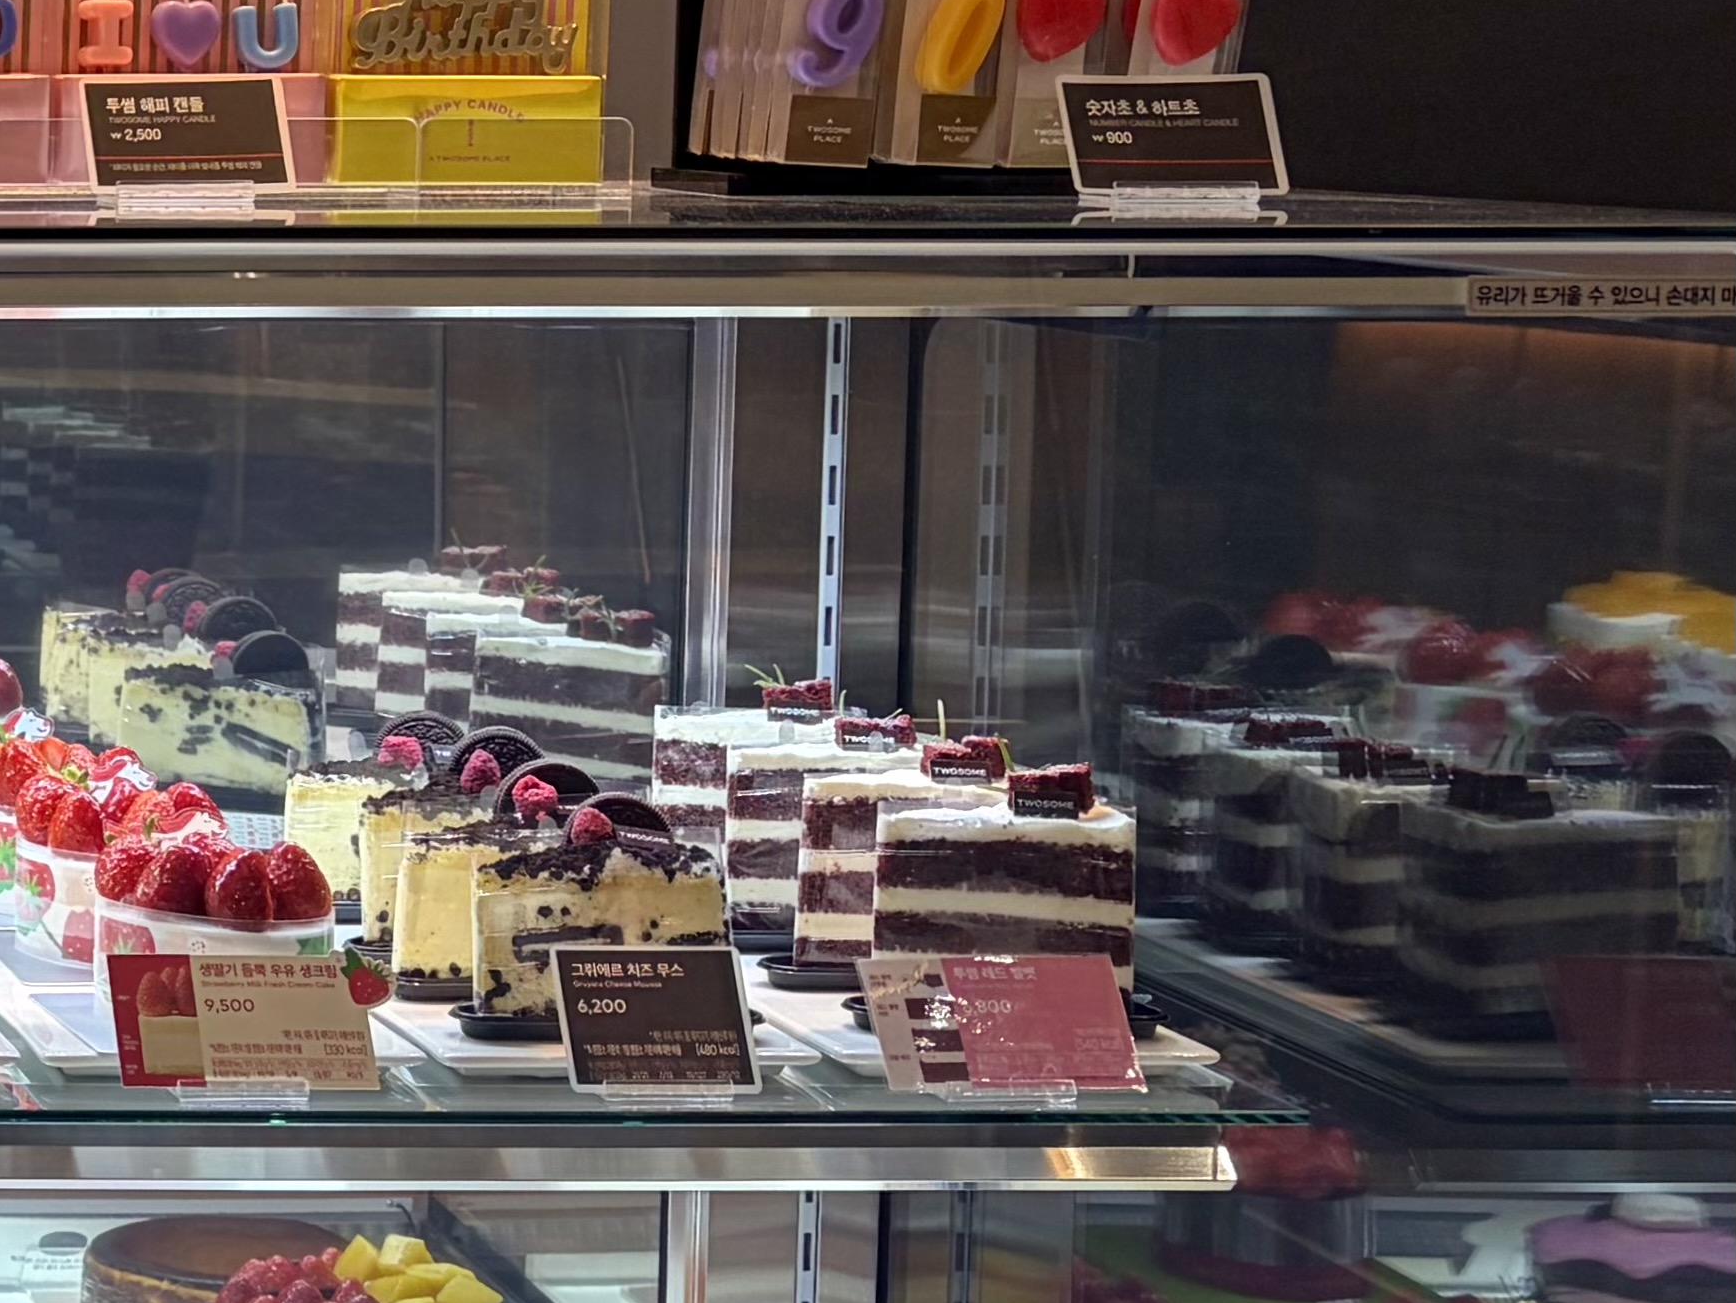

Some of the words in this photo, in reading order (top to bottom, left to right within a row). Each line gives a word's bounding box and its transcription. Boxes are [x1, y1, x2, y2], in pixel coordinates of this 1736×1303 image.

[348, 4, 578, 75] Birthday
[105, 97, 136, 114] 투썸
[139, 96, 170, 114] 해피
[173, 96, 205, 113] 캔들
[1085, 99, 1134, 116] 숫자초
[1136, 99, 1149, 115] &
[1151, 99, 1200, 116] 하트초
[124, 128, 162, 142] 2,500
[1106, 131, 1133, 144] 900
[1477, 285, 1527, 306] 유리가
[1531, 285, 1583, 306] 뜨거울
[1588, 286, 1605, 306] 수
[1610, 285, 1661, 306] 있으니
[1666, 285, 1716, 307] 손대지
[199, 963, 238, 978] 생딸기
[241, 963, 267, 978] 듬뿍
[270, 963, 296, 978] 우유
[299, 964, 338, 979] 생크림
[571, 962, 625, 978] 그뤼에르
[627, 962, 654, 977] 치즈
[656, 962, 684, 977] 무스
[204, 998, 255, 1014] 9,500
[577, 999, 627, 1015] 6,200
